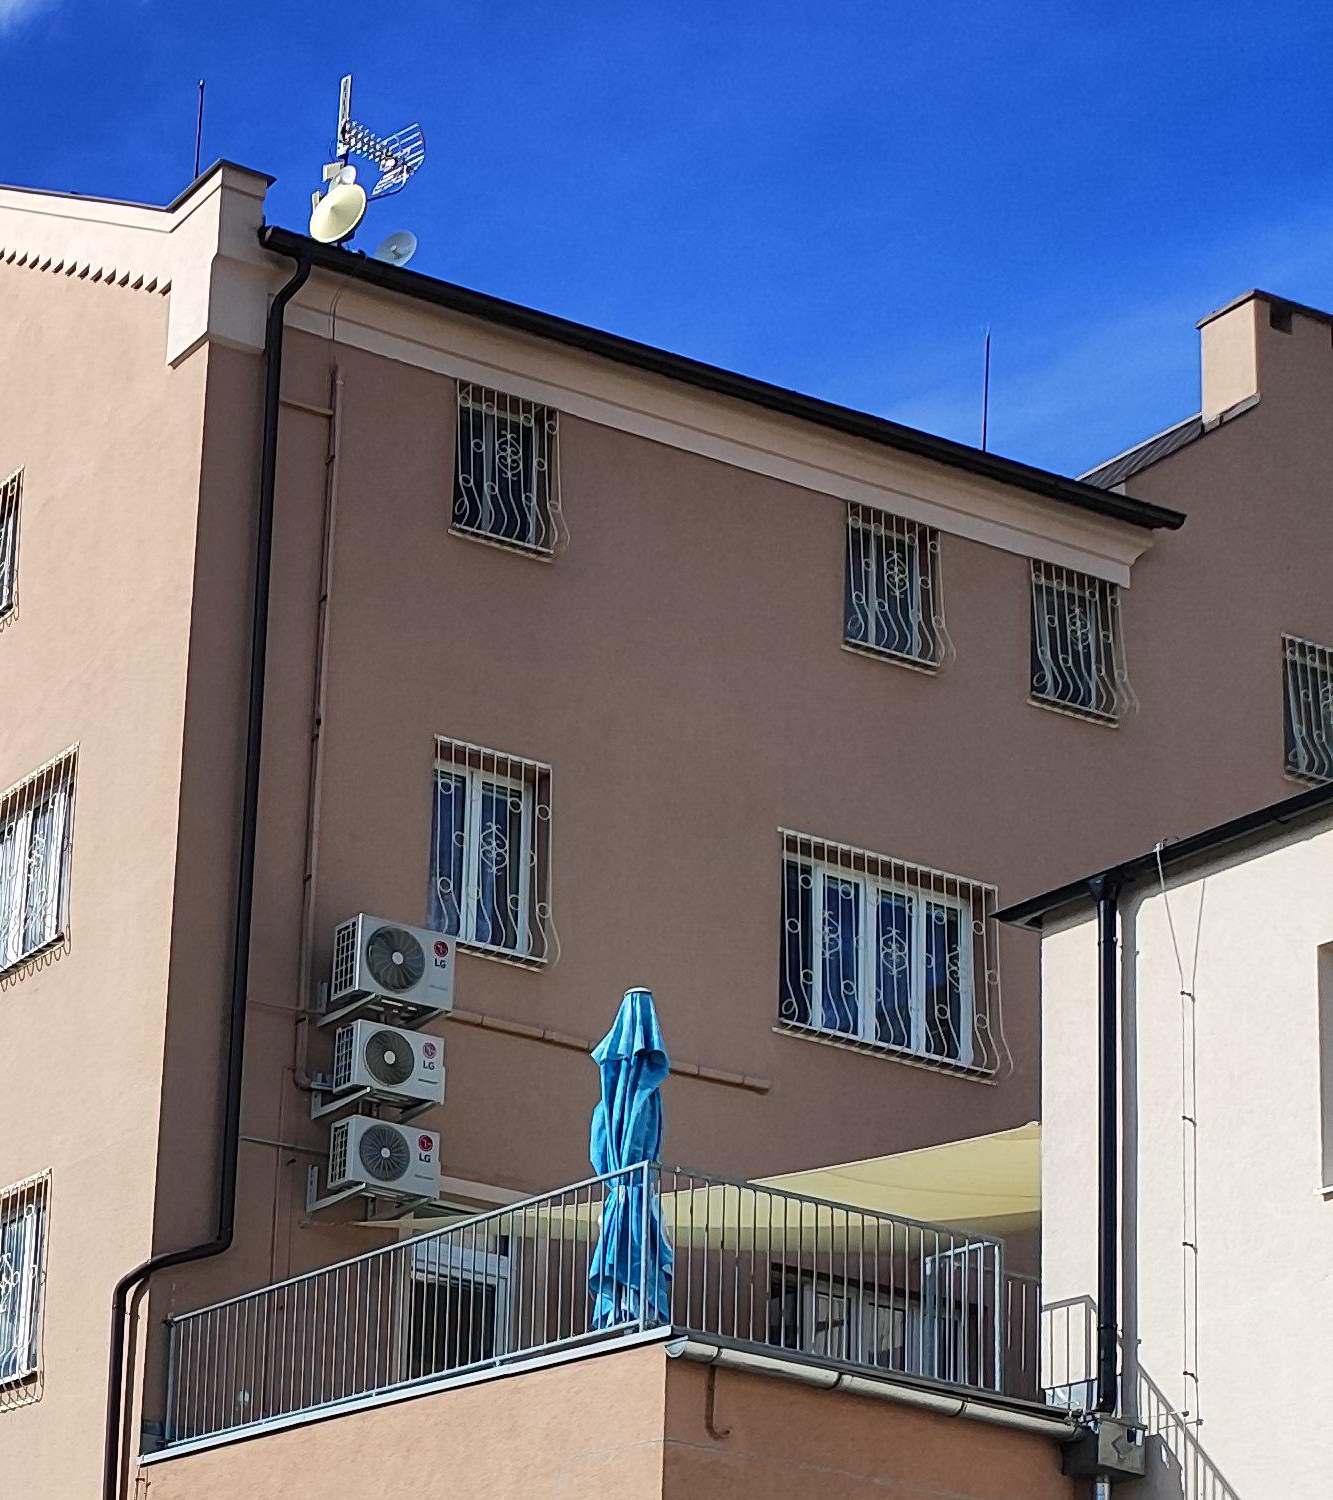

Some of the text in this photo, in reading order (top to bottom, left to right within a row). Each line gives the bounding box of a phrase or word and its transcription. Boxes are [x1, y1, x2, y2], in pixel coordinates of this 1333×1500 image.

[434, 958, 447, 969] LG
[423, 1060, 435, 1071] LG
[419, 1152, 431, 1163] LG
